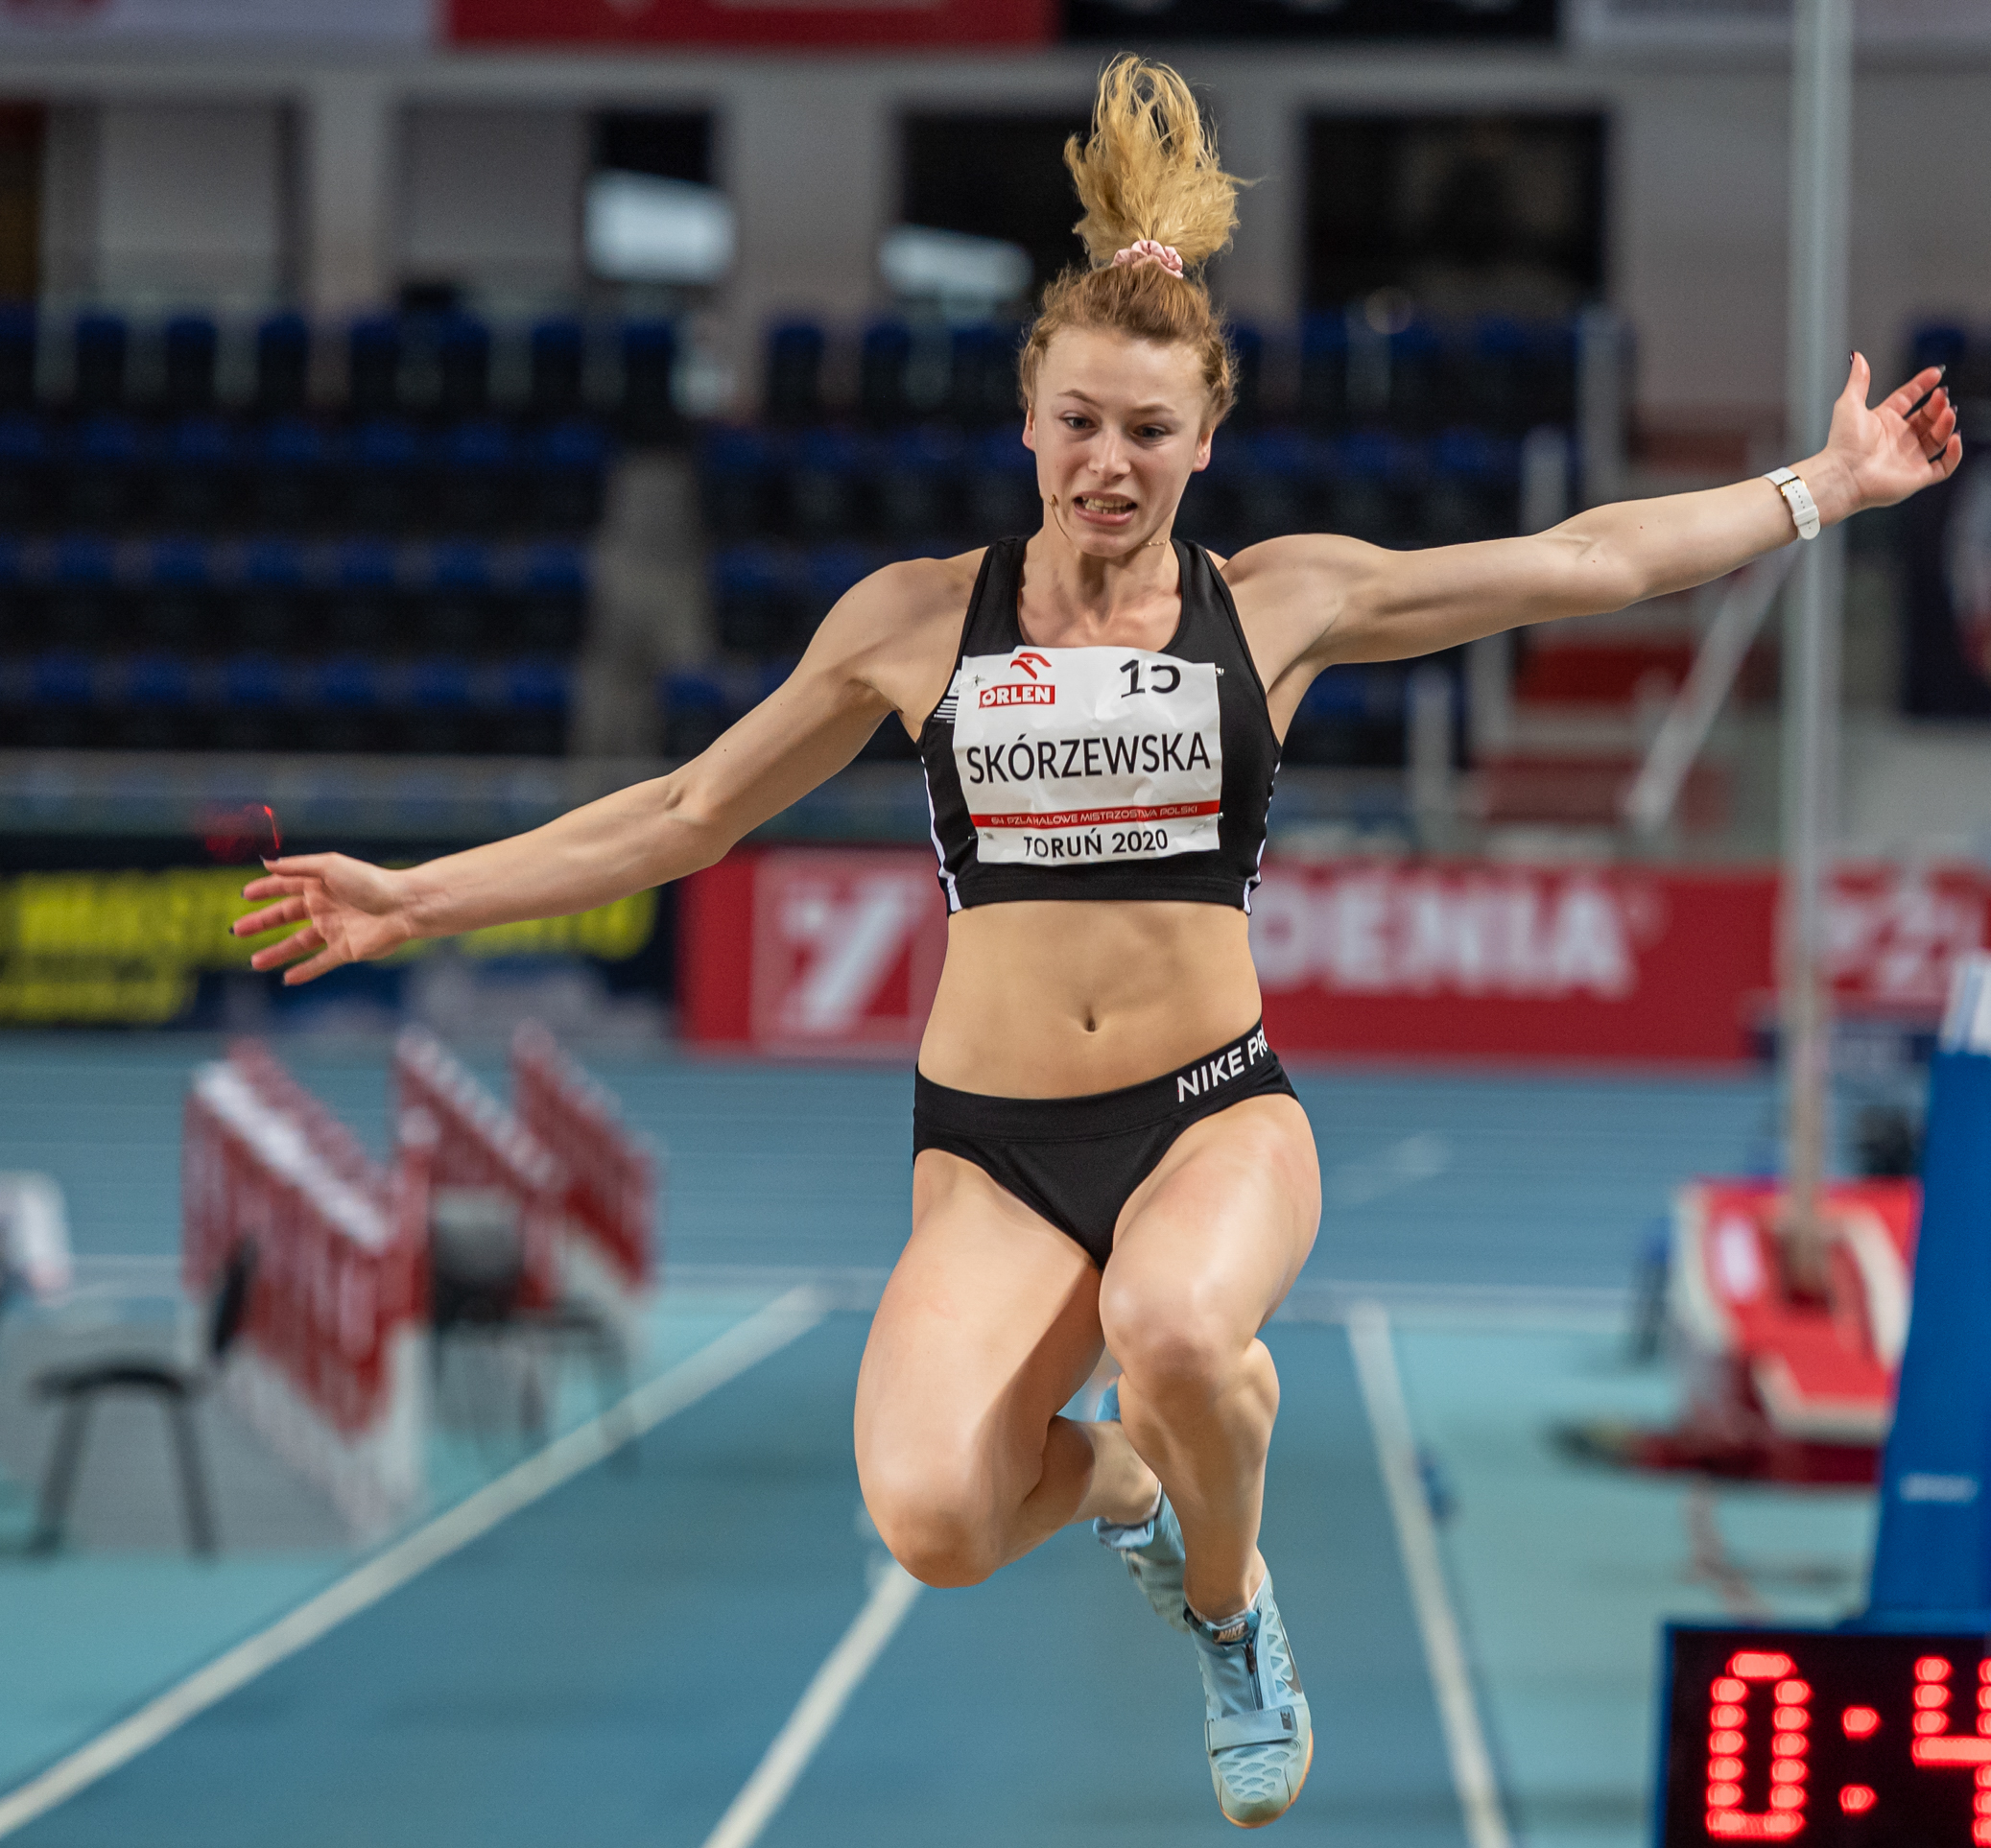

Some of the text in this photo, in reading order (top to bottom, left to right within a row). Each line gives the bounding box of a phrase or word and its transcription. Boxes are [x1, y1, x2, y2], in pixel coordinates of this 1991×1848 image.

[982, 685, 1052, 706] ORLEN
[965, 731, 1212, 785] SKÓRZEWSKA
[1079, 808, 1158, 822] MISTRZOSTWA
[1159, 805, 1198, 817] POLSKI
[1023, 827, 1169, 859] TORUŃ 2020
[1176, 1045, 1245, 1103] NIKE
